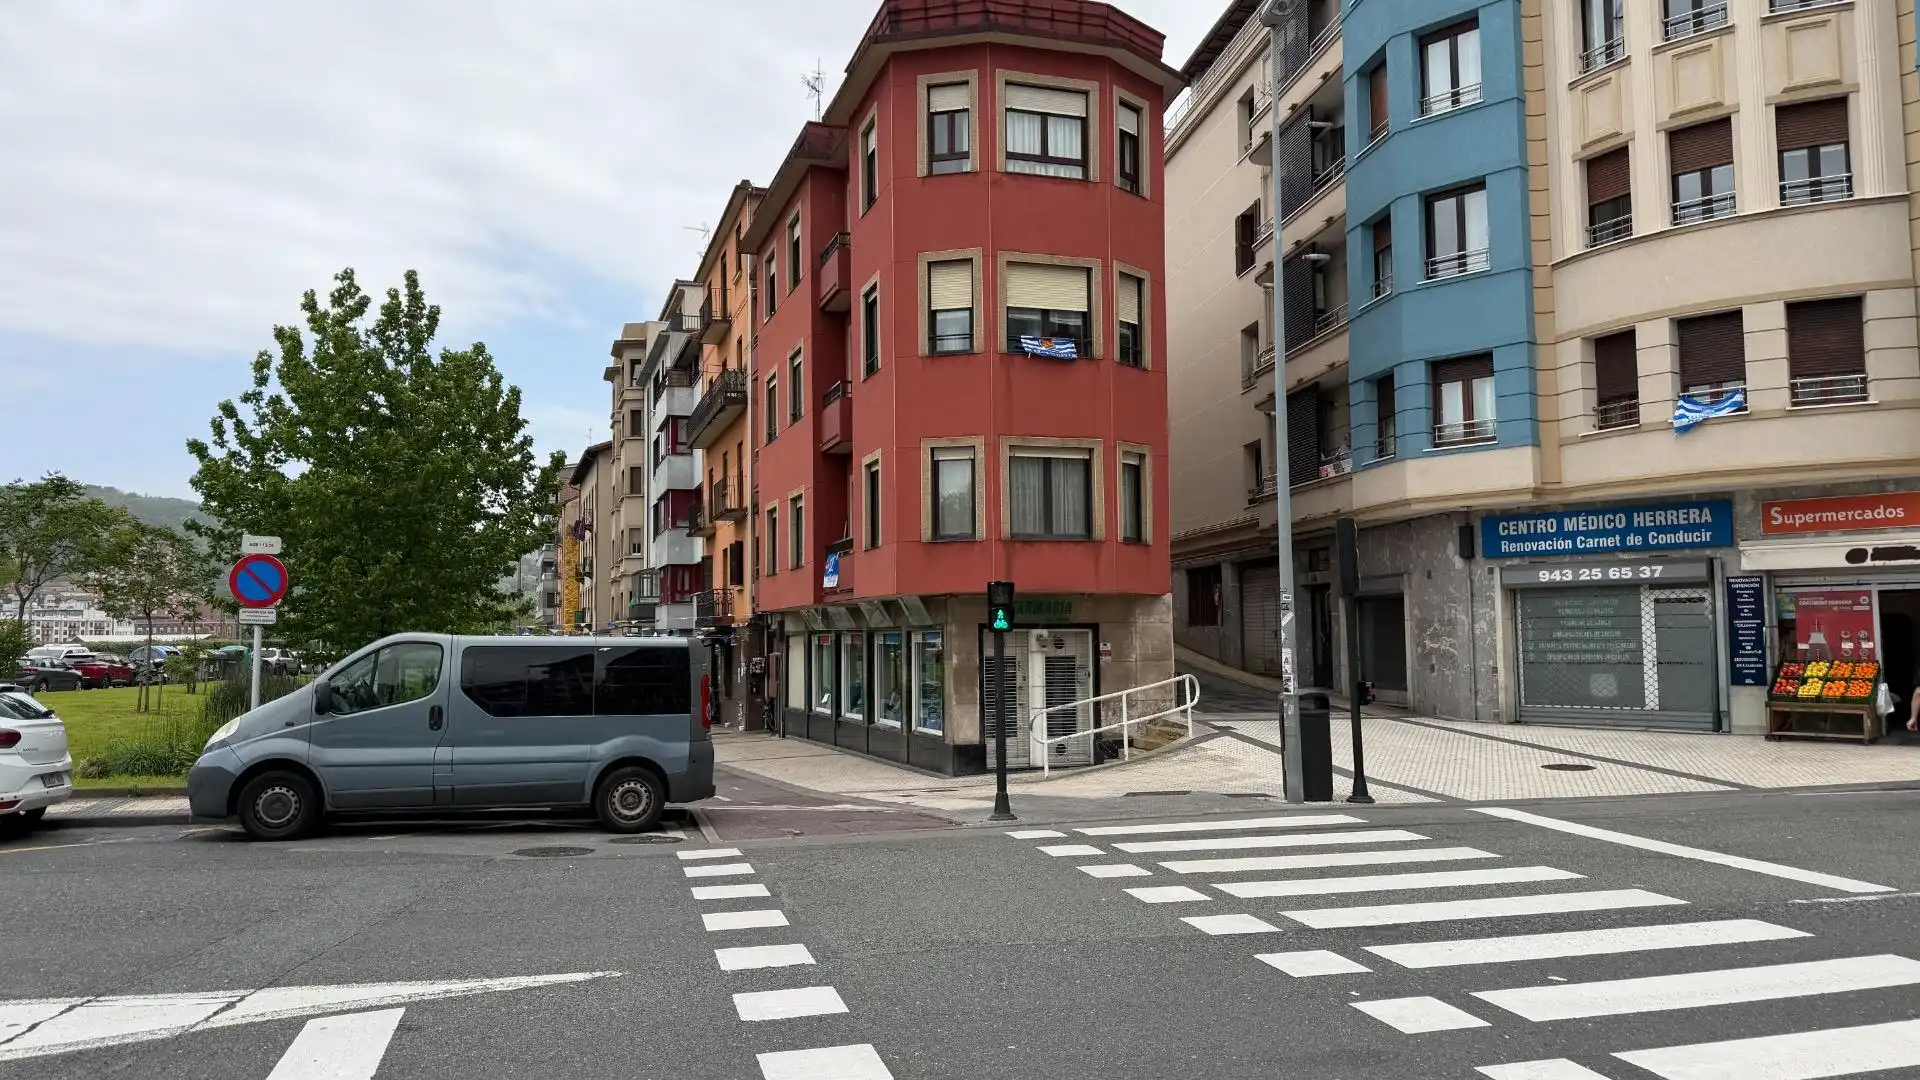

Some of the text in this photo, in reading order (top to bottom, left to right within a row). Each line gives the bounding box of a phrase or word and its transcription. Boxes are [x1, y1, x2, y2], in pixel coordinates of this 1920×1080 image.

[1499, 508, 1713, 536] CENTRO MÉDICO HERRERA
[1769, 504, 1905, 528] Supermercados
[1501, 529, 1712, 553] Renovación Carnet de Conducir
[1538, 565, 1663, 582] 943 25 65 37
